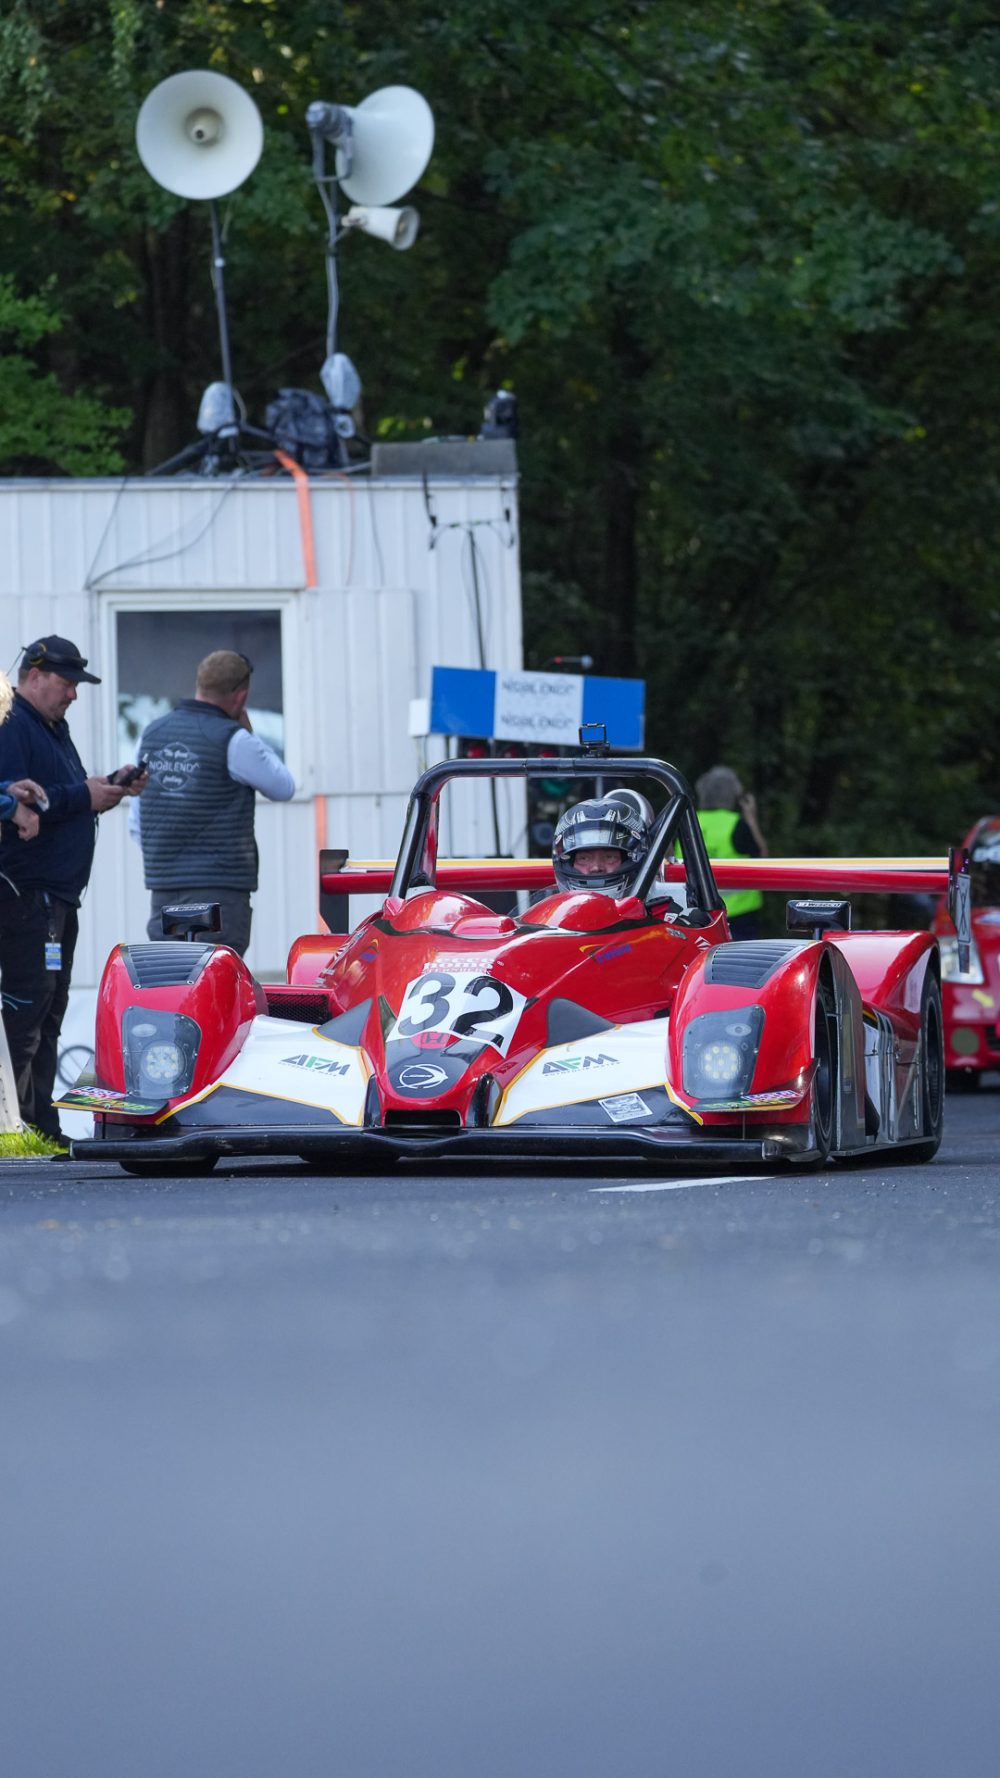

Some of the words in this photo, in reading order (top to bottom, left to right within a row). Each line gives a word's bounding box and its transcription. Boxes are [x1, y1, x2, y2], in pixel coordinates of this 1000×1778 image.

[397, 972, 514, 1049] 32
[281, 1054, 351, 1076] AFM
[542, 1053, 619, 1074] AFM
